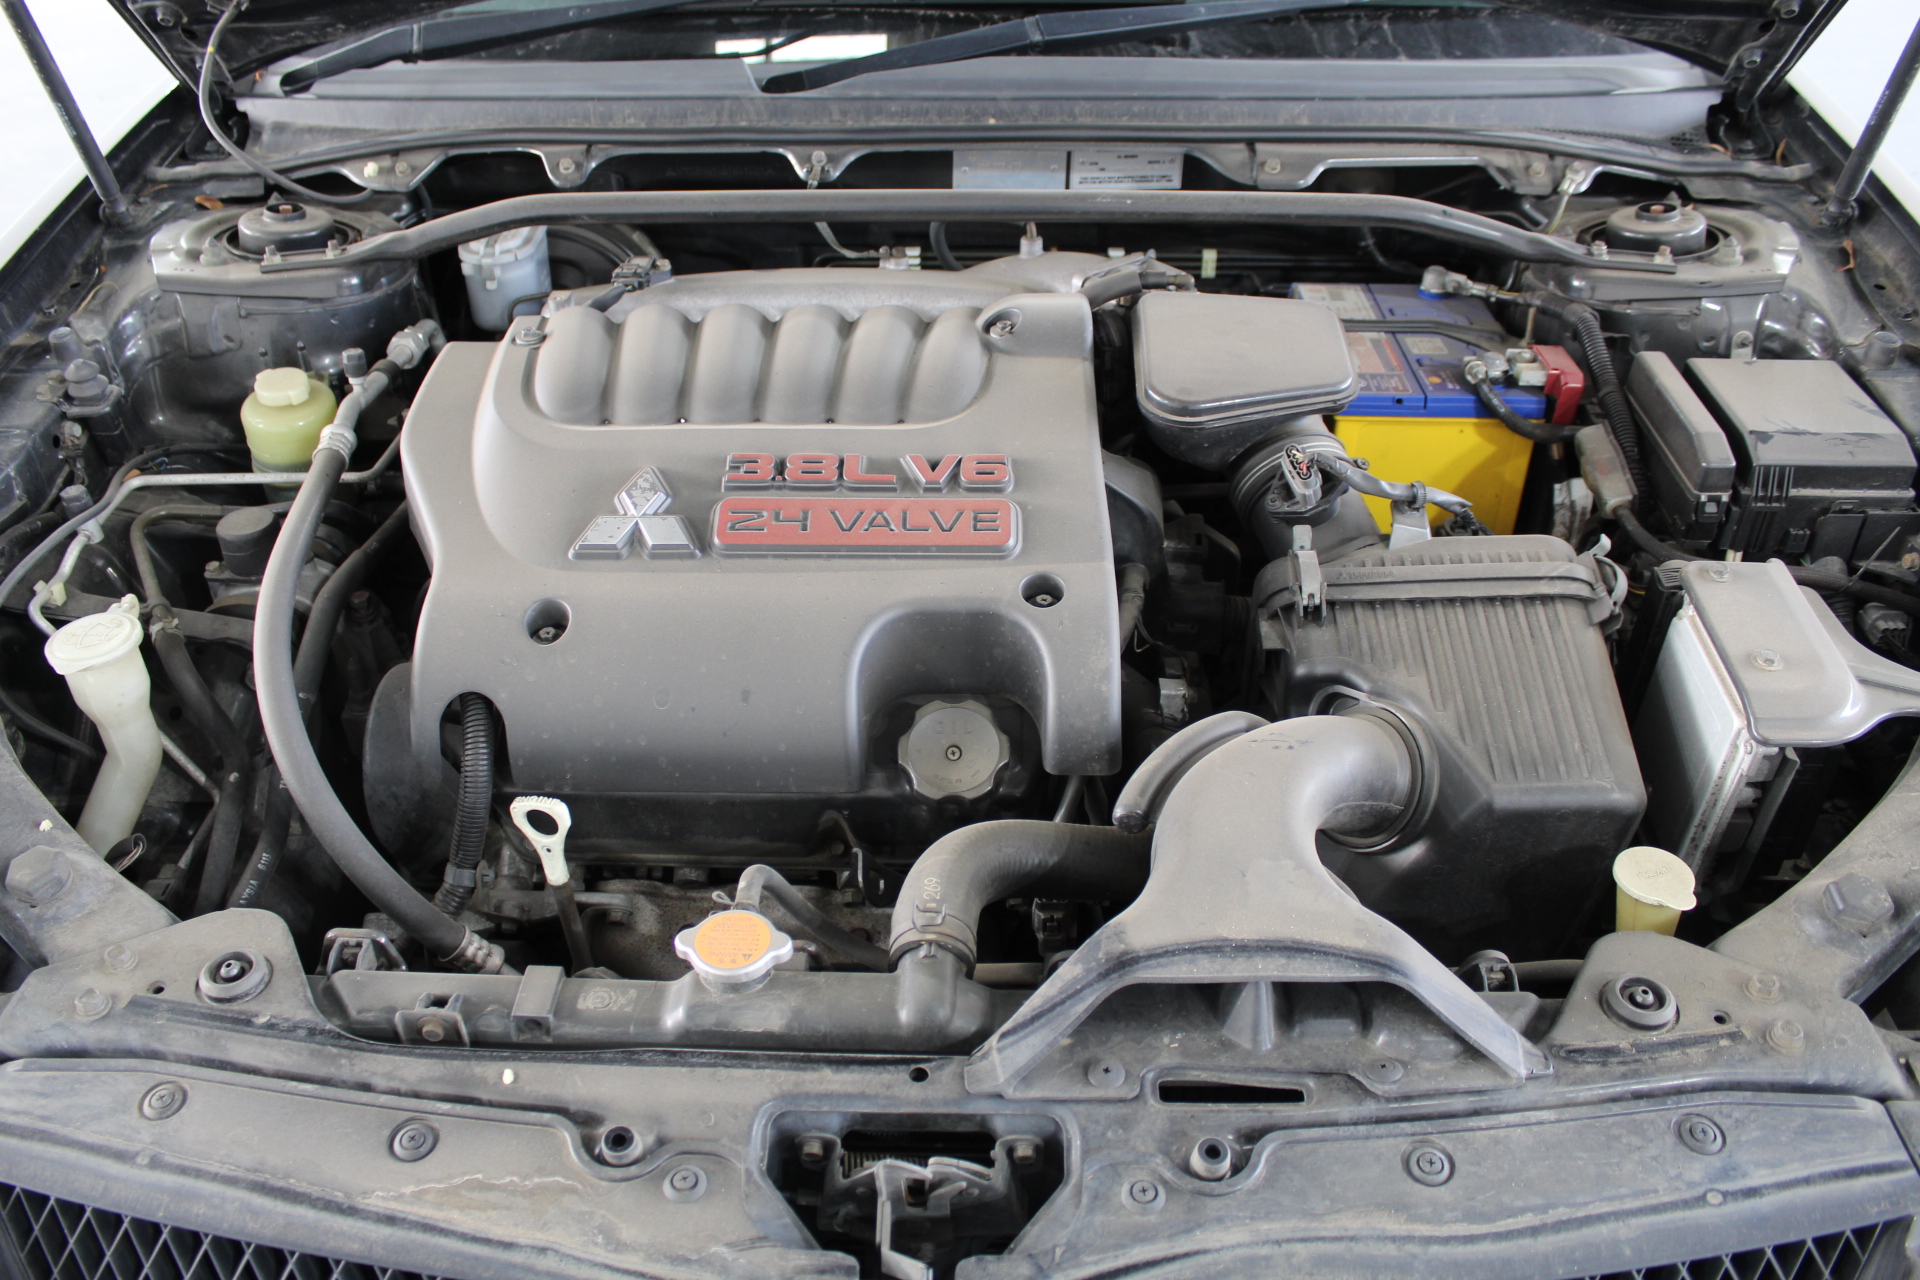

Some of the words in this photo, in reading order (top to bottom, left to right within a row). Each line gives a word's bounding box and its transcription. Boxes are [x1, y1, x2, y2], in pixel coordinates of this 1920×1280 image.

[723, 452, 899, 492] 3.8L
[901, 453, 1013, 493] V6
[727, 509, 812, 533] 24
[828, 509, 1001, 533] VALVE
[923, 877, 941, 900] 269
